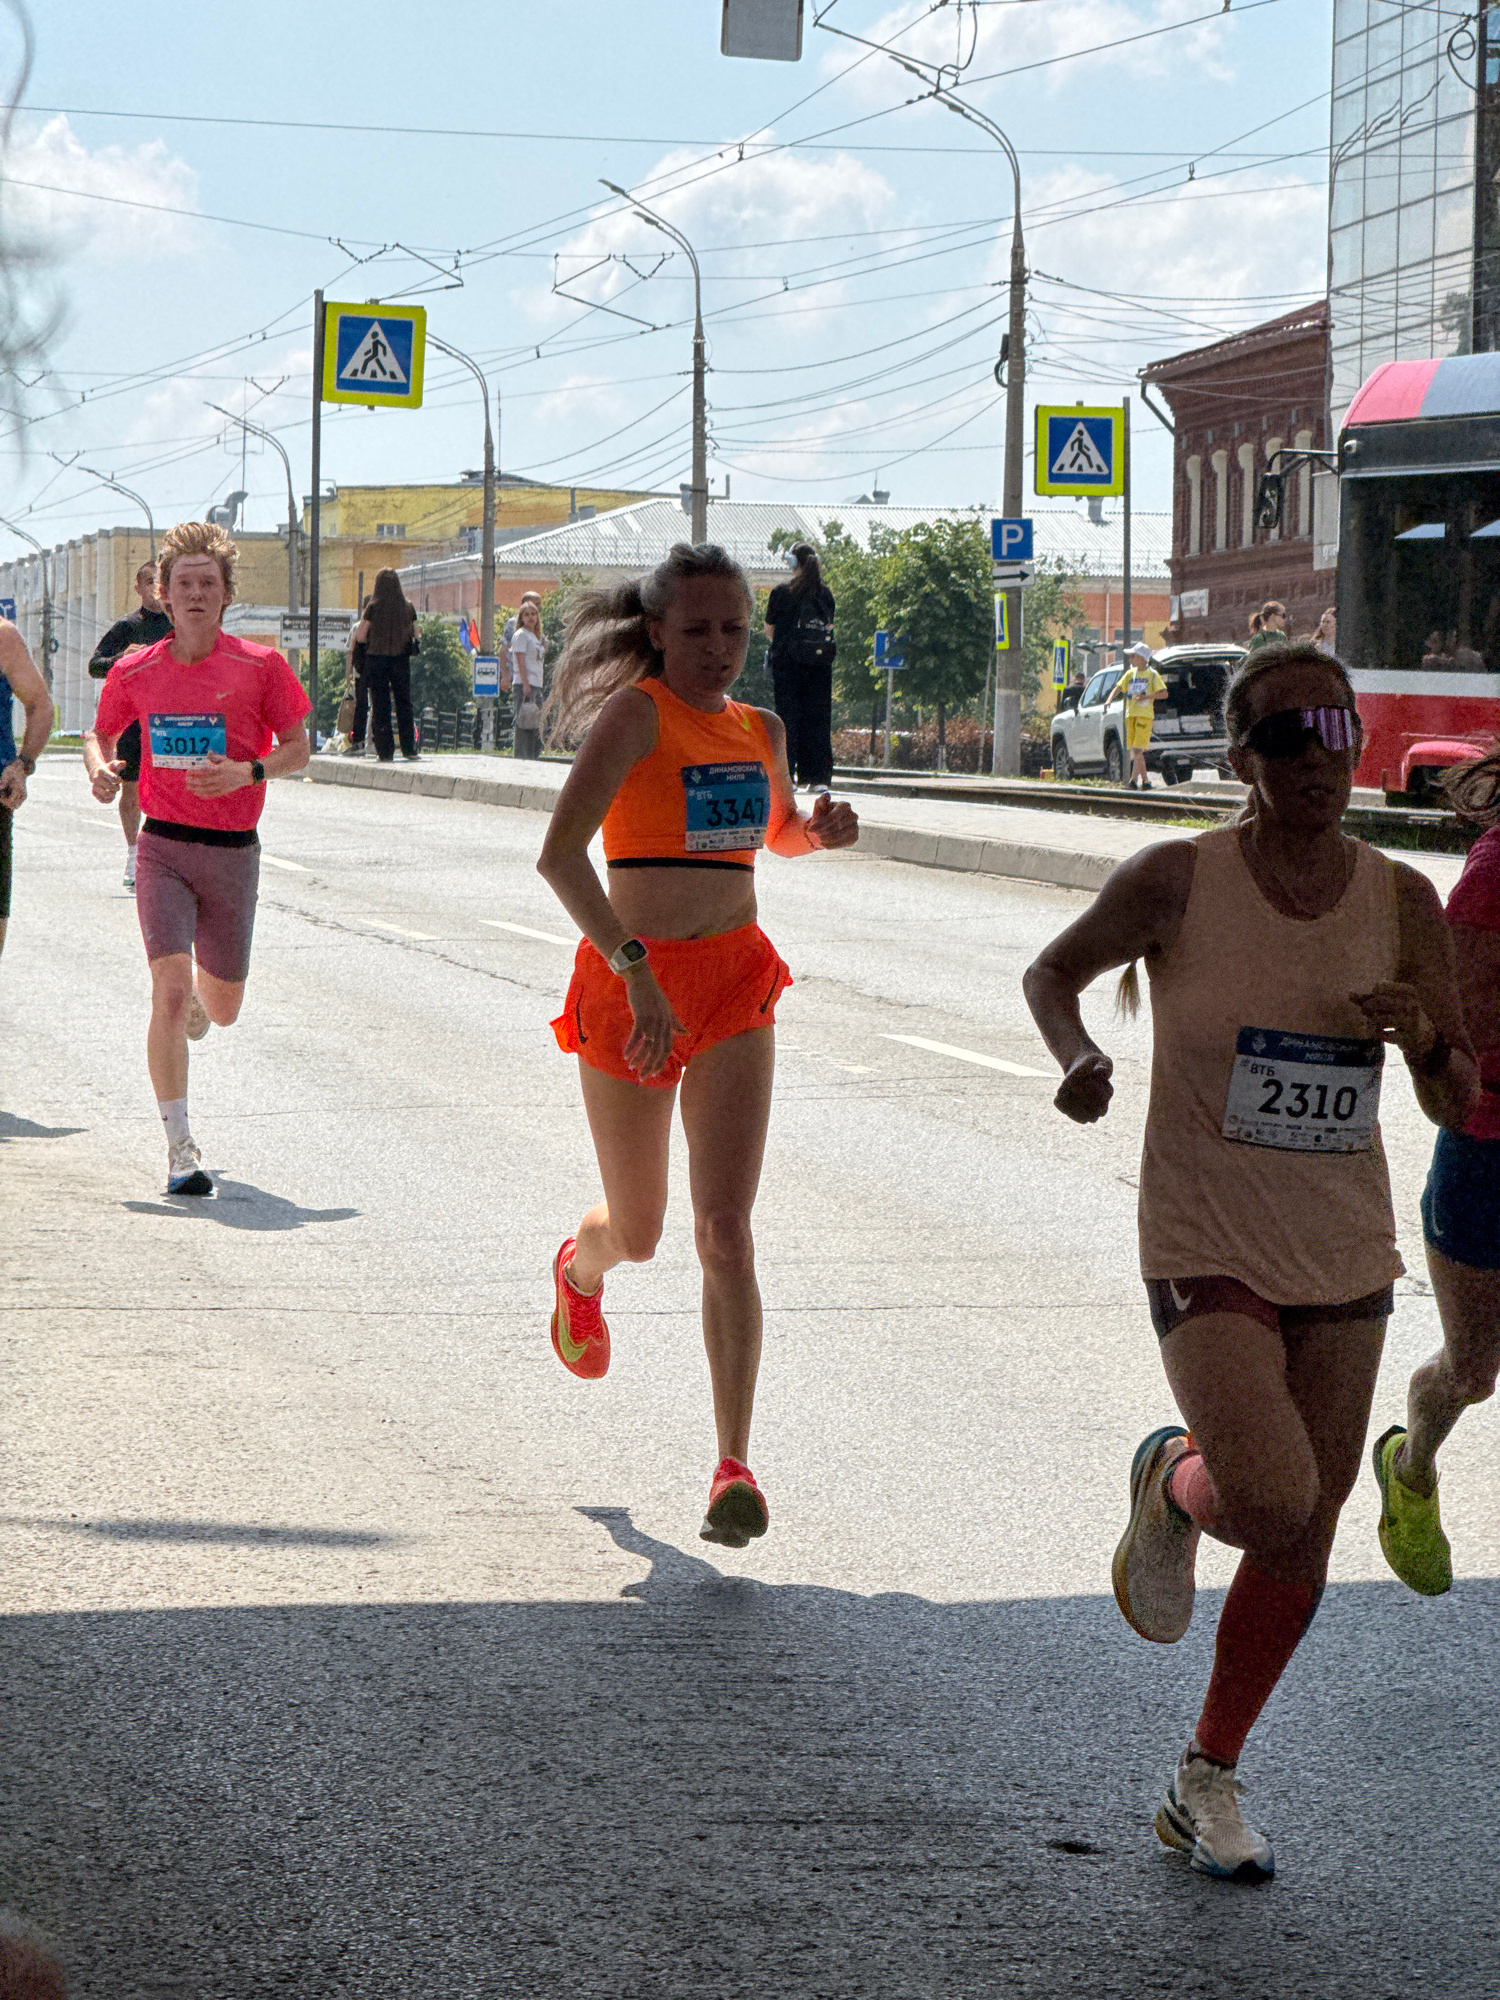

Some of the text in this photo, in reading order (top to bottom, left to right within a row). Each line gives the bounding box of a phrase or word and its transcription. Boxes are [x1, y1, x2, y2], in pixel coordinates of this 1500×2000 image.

[1001, 524, 1024, 556] P
[162, 737, 210, 755] 3012
[708, 765, 758, 775] ДИНАМОВСКАЯ
[696, 790, 713, 800] ВТБ
[706, 798, 764, 827] 3347
[1250, 1063, 1276, 1077] ВТБ
[1257, 1078, 1358, 1121] 2310
